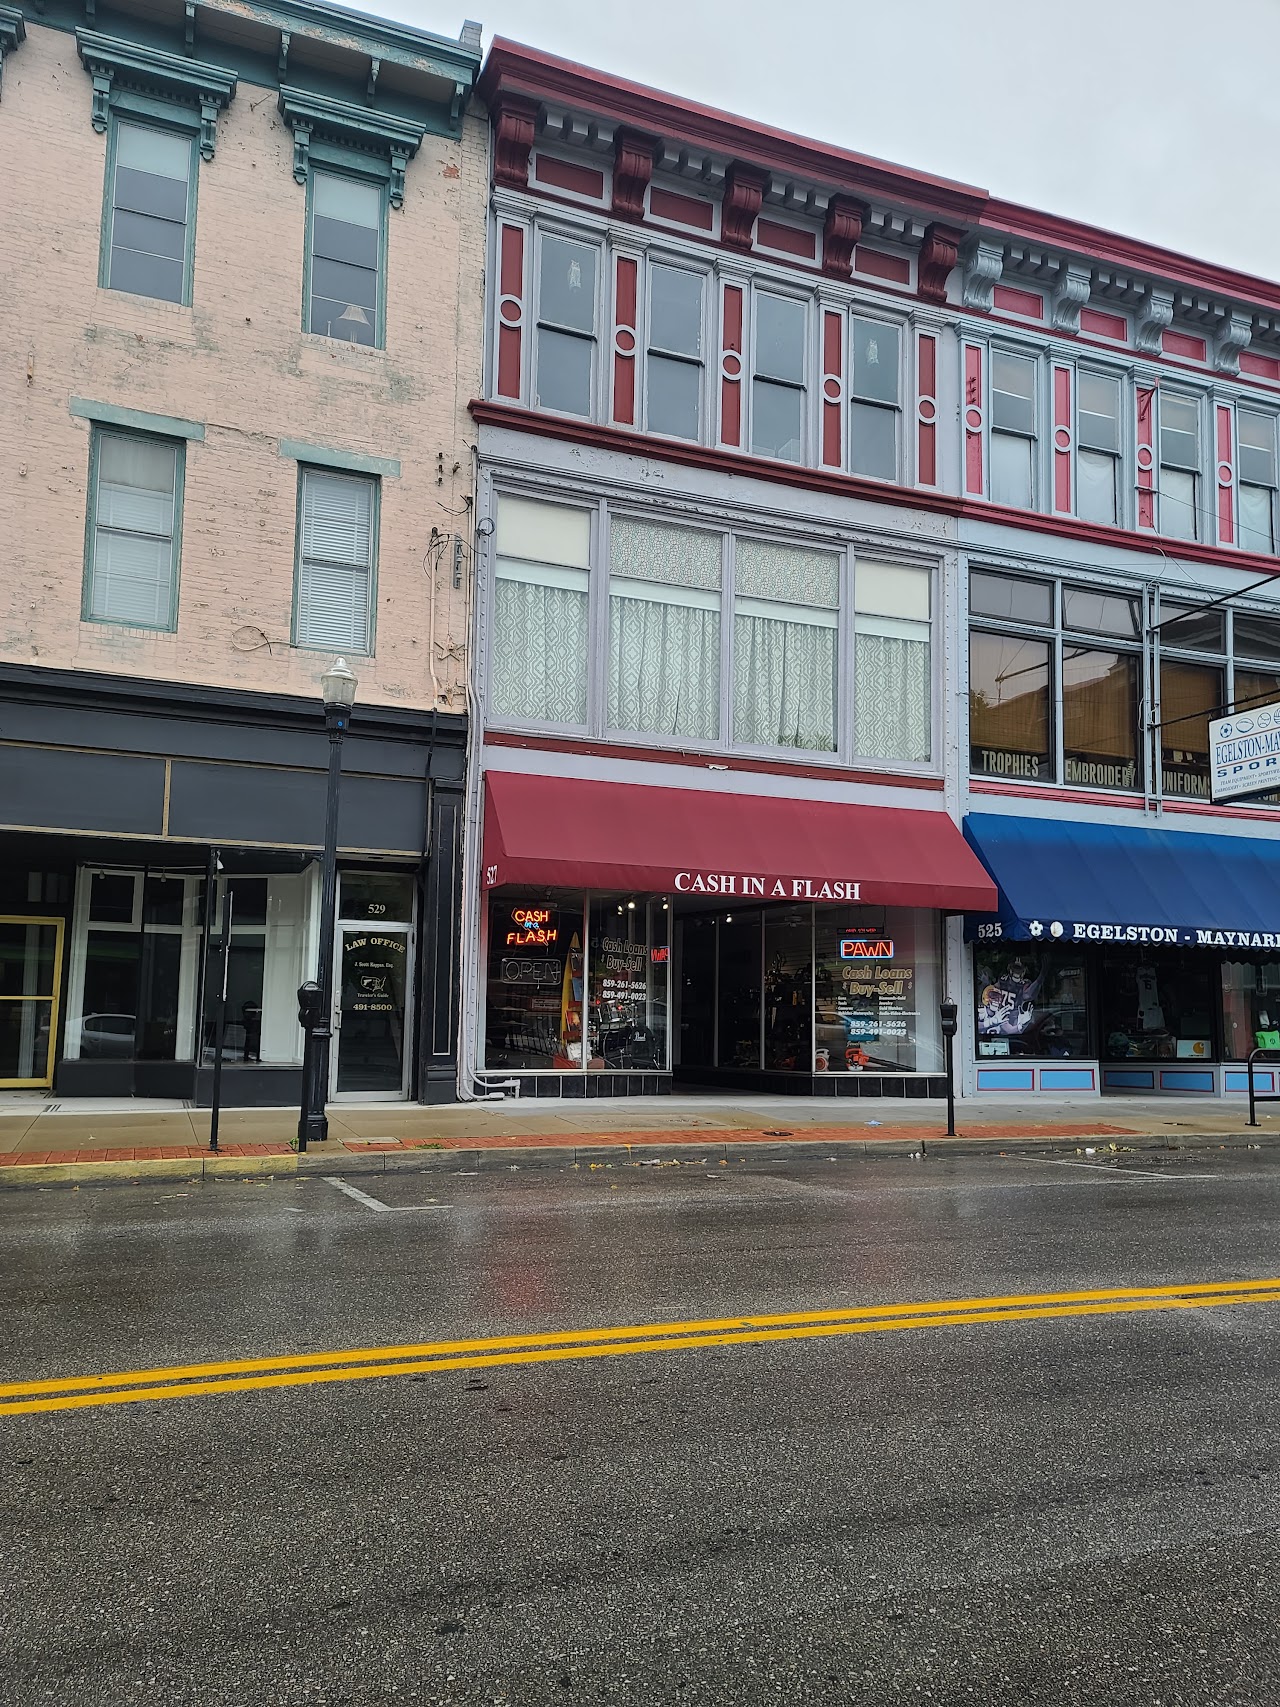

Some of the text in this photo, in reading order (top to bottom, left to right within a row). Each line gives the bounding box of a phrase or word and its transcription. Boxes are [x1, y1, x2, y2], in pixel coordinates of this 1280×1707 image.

[1216, 731, 1280, 766] EGELSTON-MA
[982, 750, 1039, 778] TROPHIES
[486, 865, 498, 885] 527
[674, 872, 861, 900] CASH IN A FLASH
[367, 904, 386, 914] 529
[514, 910, 549, 922] CASH
[506, 929, 557, 945] FLASH
[977, 923, 1003, 938] 525
[1072, 923, 1178, 943] EGELSTON
[345, 937, 406, 954] LAW OFFICE
[602, 936, 648, 956] Cash Loans
[843, 942, 892, 957] PAWN
[505, 961, 559, 981] OPEN
[606, 955, 643, 973] Buy-Sell
[842, 965, 913, 980] Cash Loans
[602, 979, 647, 990] 859-261-5626
[849, 980, 904, 997] Buy-Sell
[602, 990, 647, 1001] 859-491-0023
[1001, 989, 1017, 1011] 75
[352, 1003, 393, 1011] 491-8500
[850, 1020, 907, 1028] 859-261-5626
[850, 1028, 907, 1036] 859-491-0023
